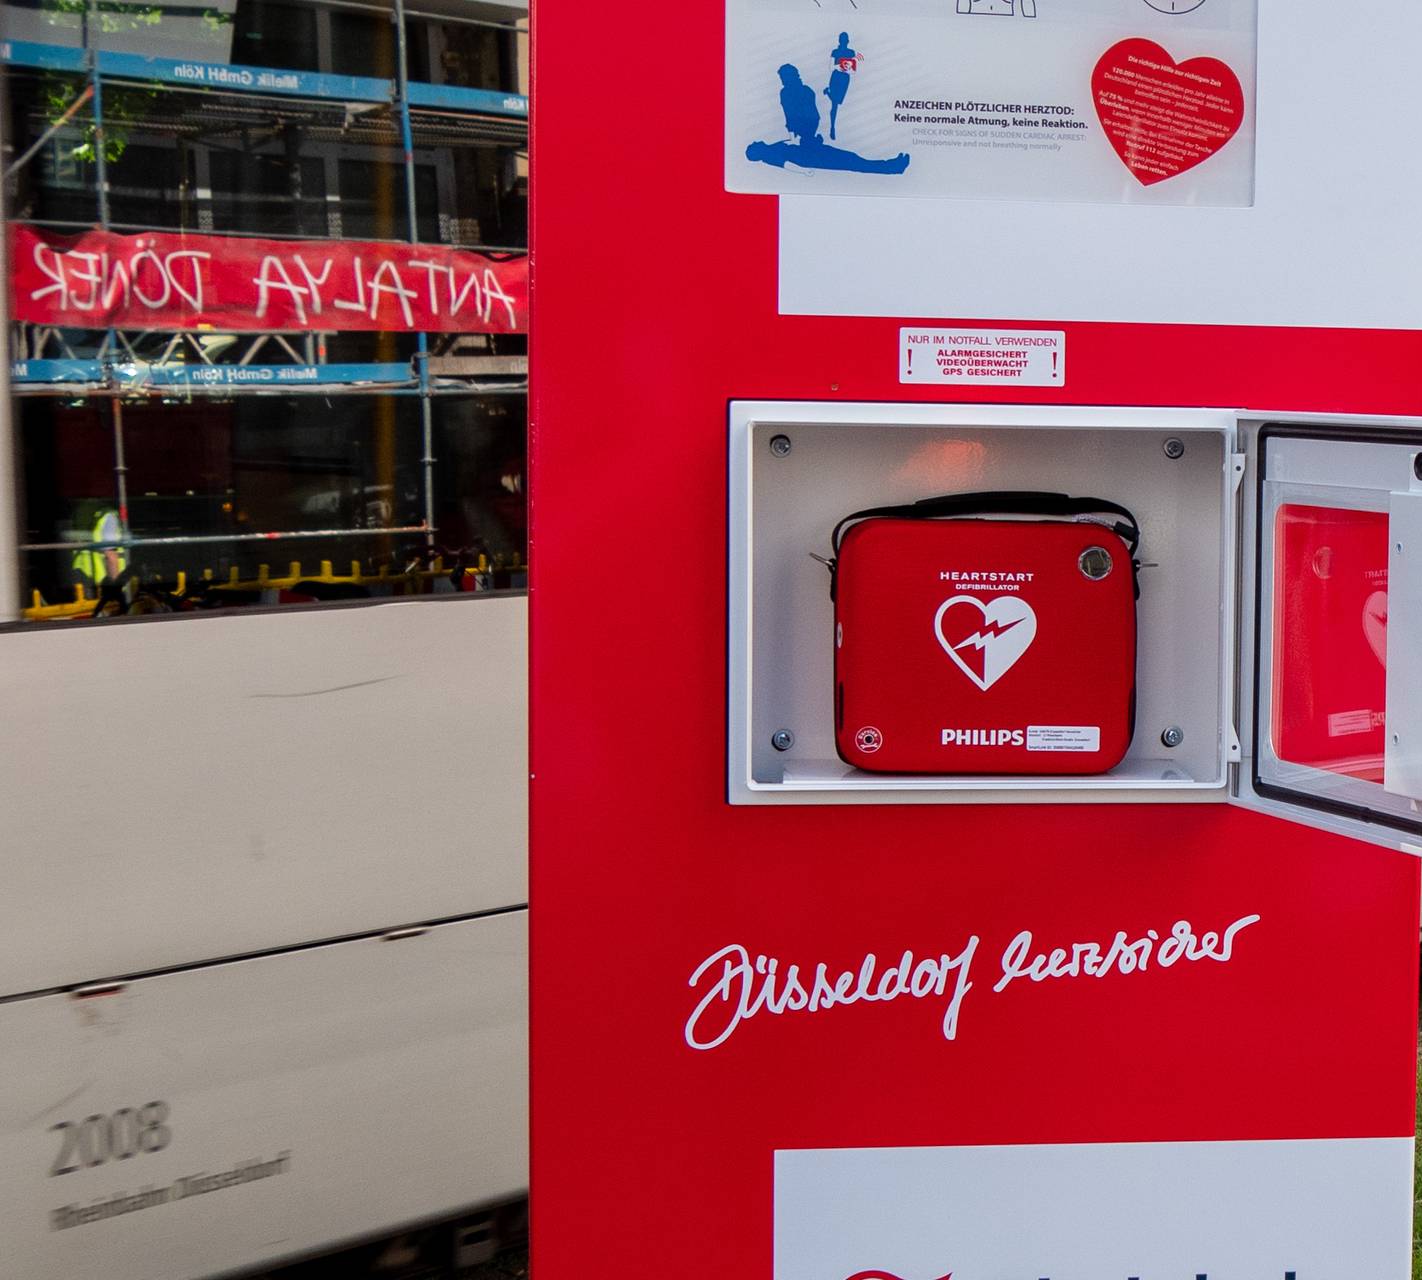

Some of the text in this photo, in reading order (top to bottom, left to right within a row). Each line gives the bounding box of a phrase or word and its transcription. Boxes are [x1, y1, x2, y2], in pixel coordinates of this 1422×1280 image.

[1137, 58, 1160, 69] richtige
[1160, 64, 1174, 72] Hilfe
[1184, 71, 1209, 83] richtigen
[1104, 72, 1137, 85] Deutschland
[895, 100, 1074, 115] ANZEICHEN PLÖTZLICHER HERZTOD:
[894, 114, 1088, 129] Keine normale Atmung, keine Reaktion.
[912, 128, 937, 136] CHECK
[978, 130, 988, 138] OF
[1023, 132, 1055, 140] CARDIAC
[1057, 133, 1086, 142] ARREST:
[912, 138, 1062, 152] Unresponsive and not breathing normally
[908, 336, 1056, 346] NUR IM NOTFALL VERWENDEN
[937, 350, 1028, 358] ALARMGESICHERT
[936, 358, 1029, 368] VIDEOÜBERWACHT
[942, 368, 1022, 377] GPS GESICHERT
[940, 572, 1034, 582] HEARTSTART
[955, 583, 1020, 591] DEFIBRILLATOR
[942, 728, 1024, 746] PHILIPS
[684, 914, 1261, 1050] Düsseldorf herzsicher
[48, 1100, 172, 1178] 2008
